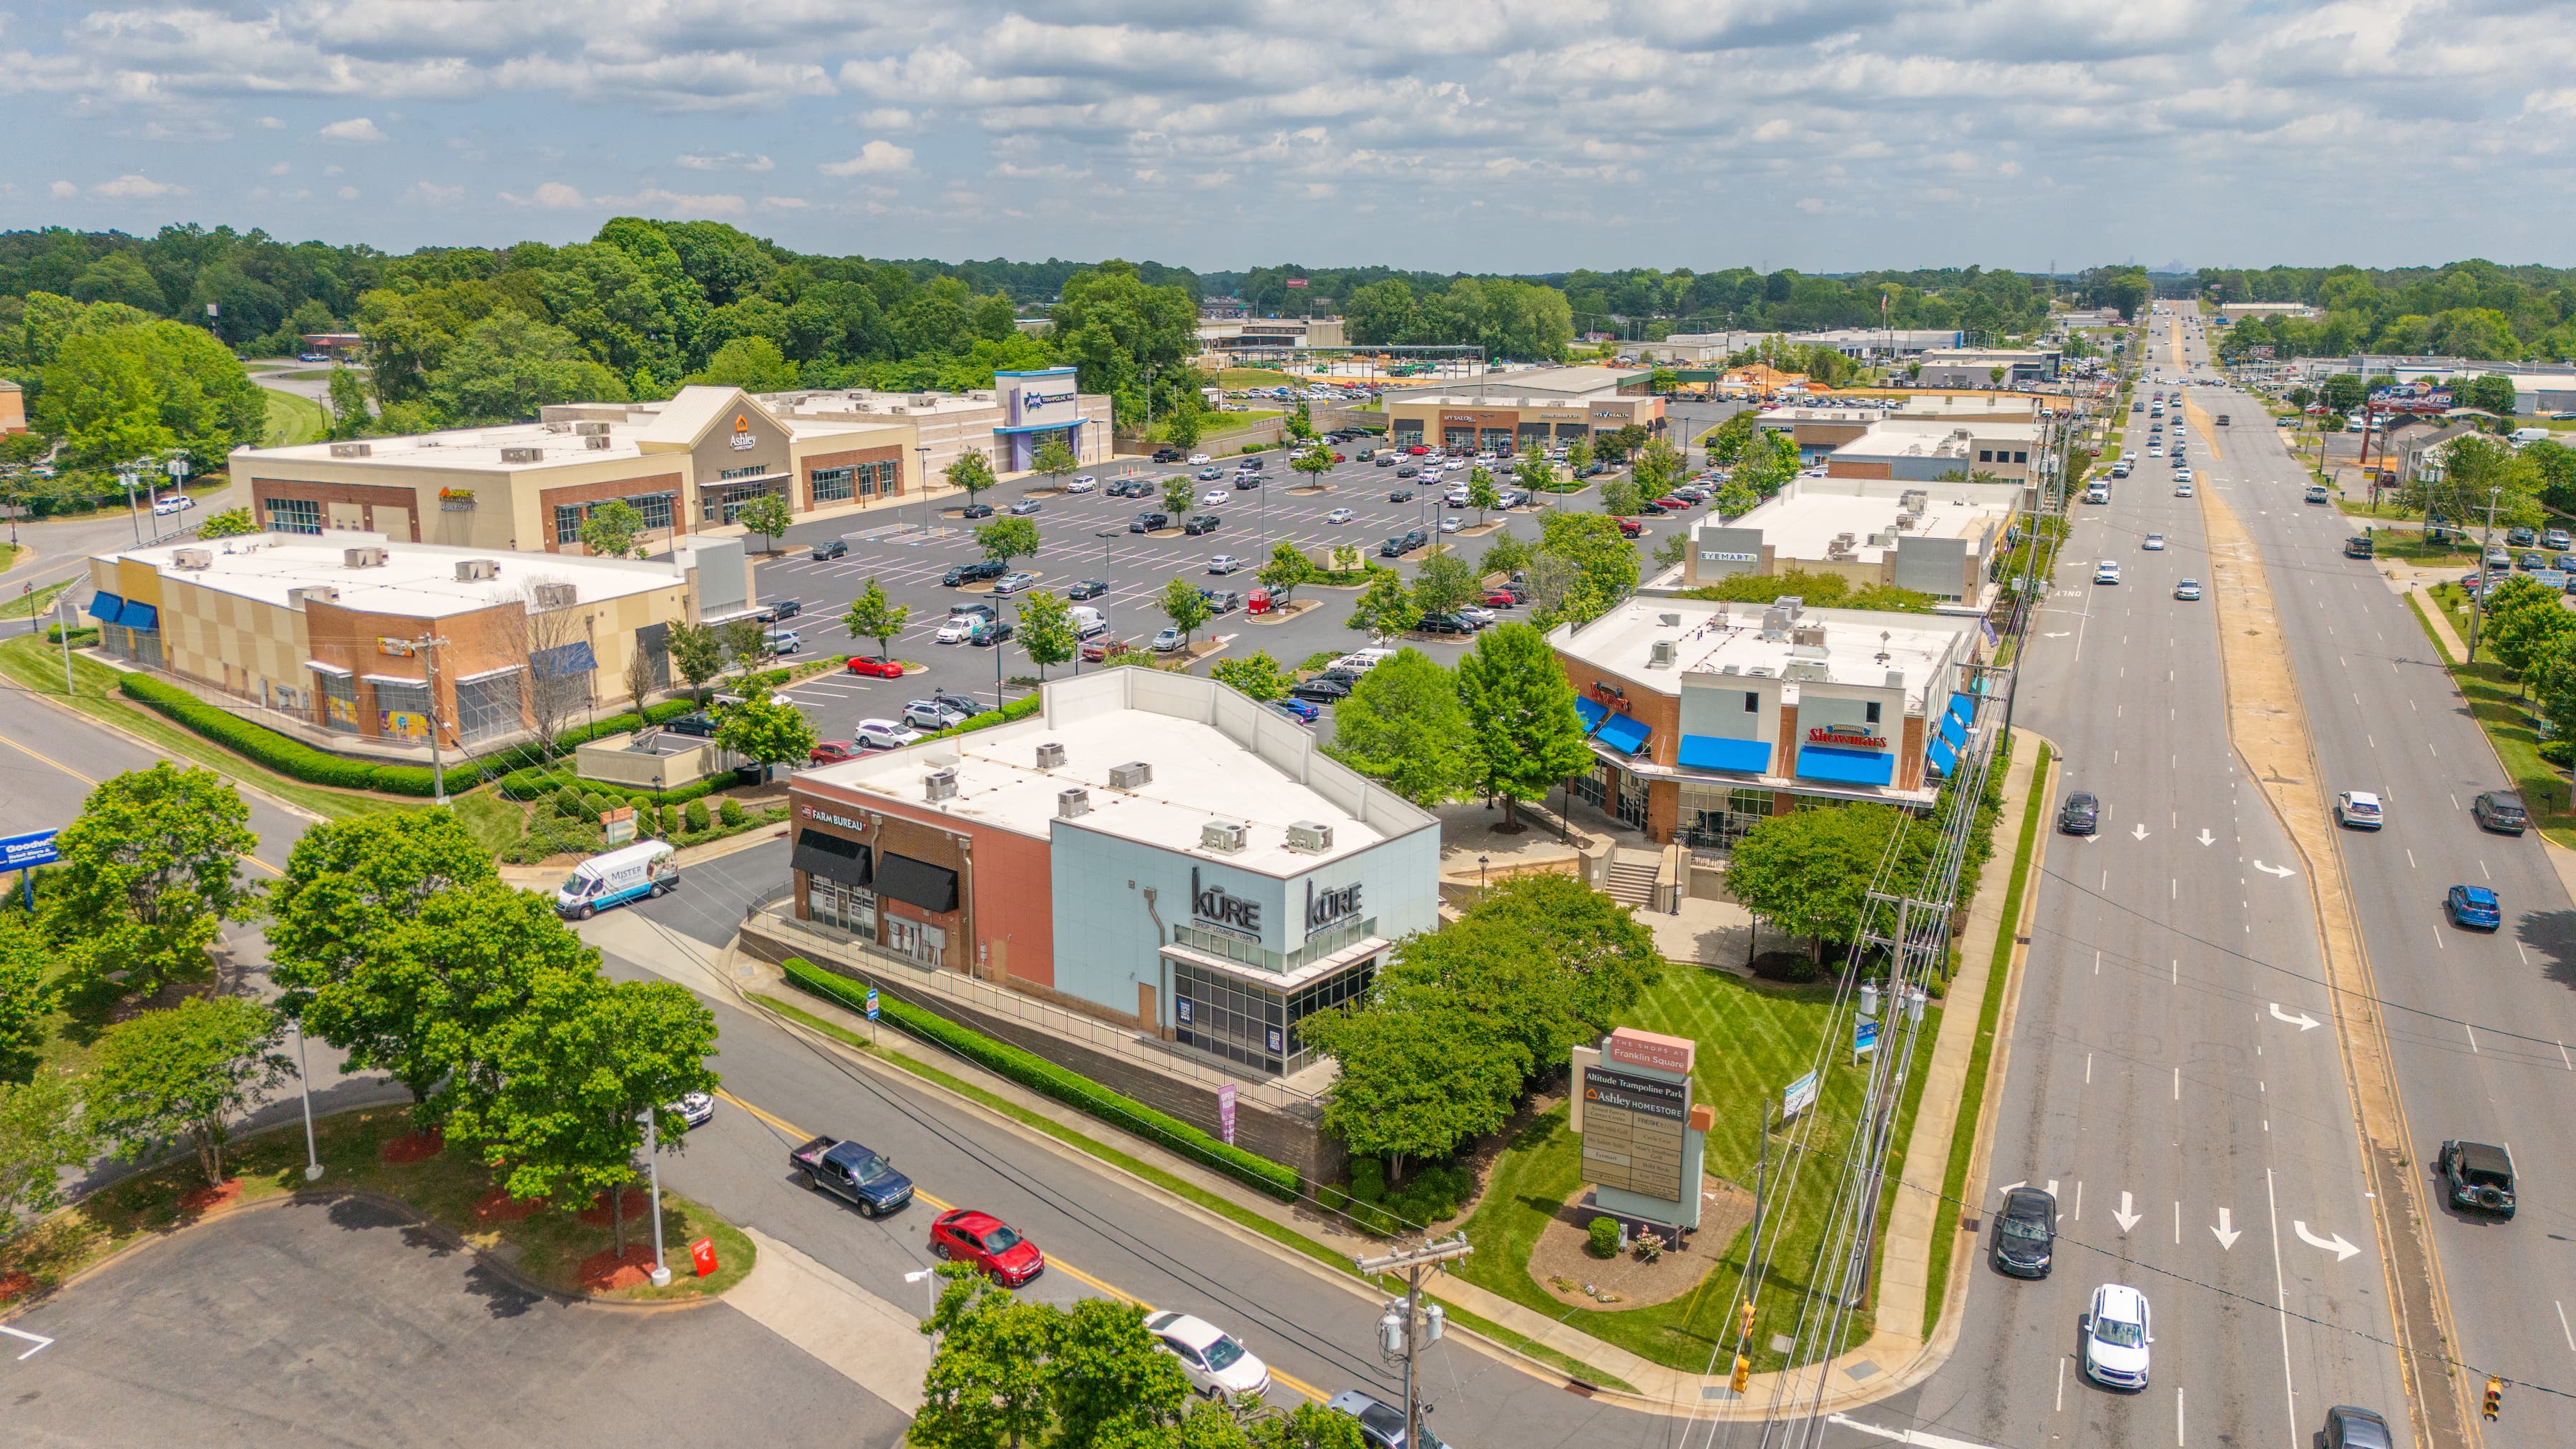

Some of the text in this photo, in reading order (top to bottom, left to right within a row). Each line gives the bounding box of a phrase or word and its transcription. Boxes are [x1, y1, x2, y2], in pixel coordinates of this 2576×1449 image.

[730, 432, 756, 447] Ashley
[1702, 552, 1749, 561] EYEMART
[1809, 728, 1887, 748] Showmars
[813, 809, 832, 824] FARM
[833, 815, 862, 831] BUREAU
[612, 865, 642, 881] MISTER
[1195, 921, 1254, 942] SHOP LOUNGE VAPE
[1638, 1043, 1668, 1053] SHOPS
[1614, 1048, 1684, 1069] Franklin Square
[1586, 1073, 1684, 1099] Altitude Trampoline Park
[1221, 1091, 1234, 1101] OPEN
[1222, 1099, 1234, 1109] NOW
[1598, 1091, 1682, 1118] Ashley HOMESTORE
[1596, 1151, 1617, 1161] Eyemart
